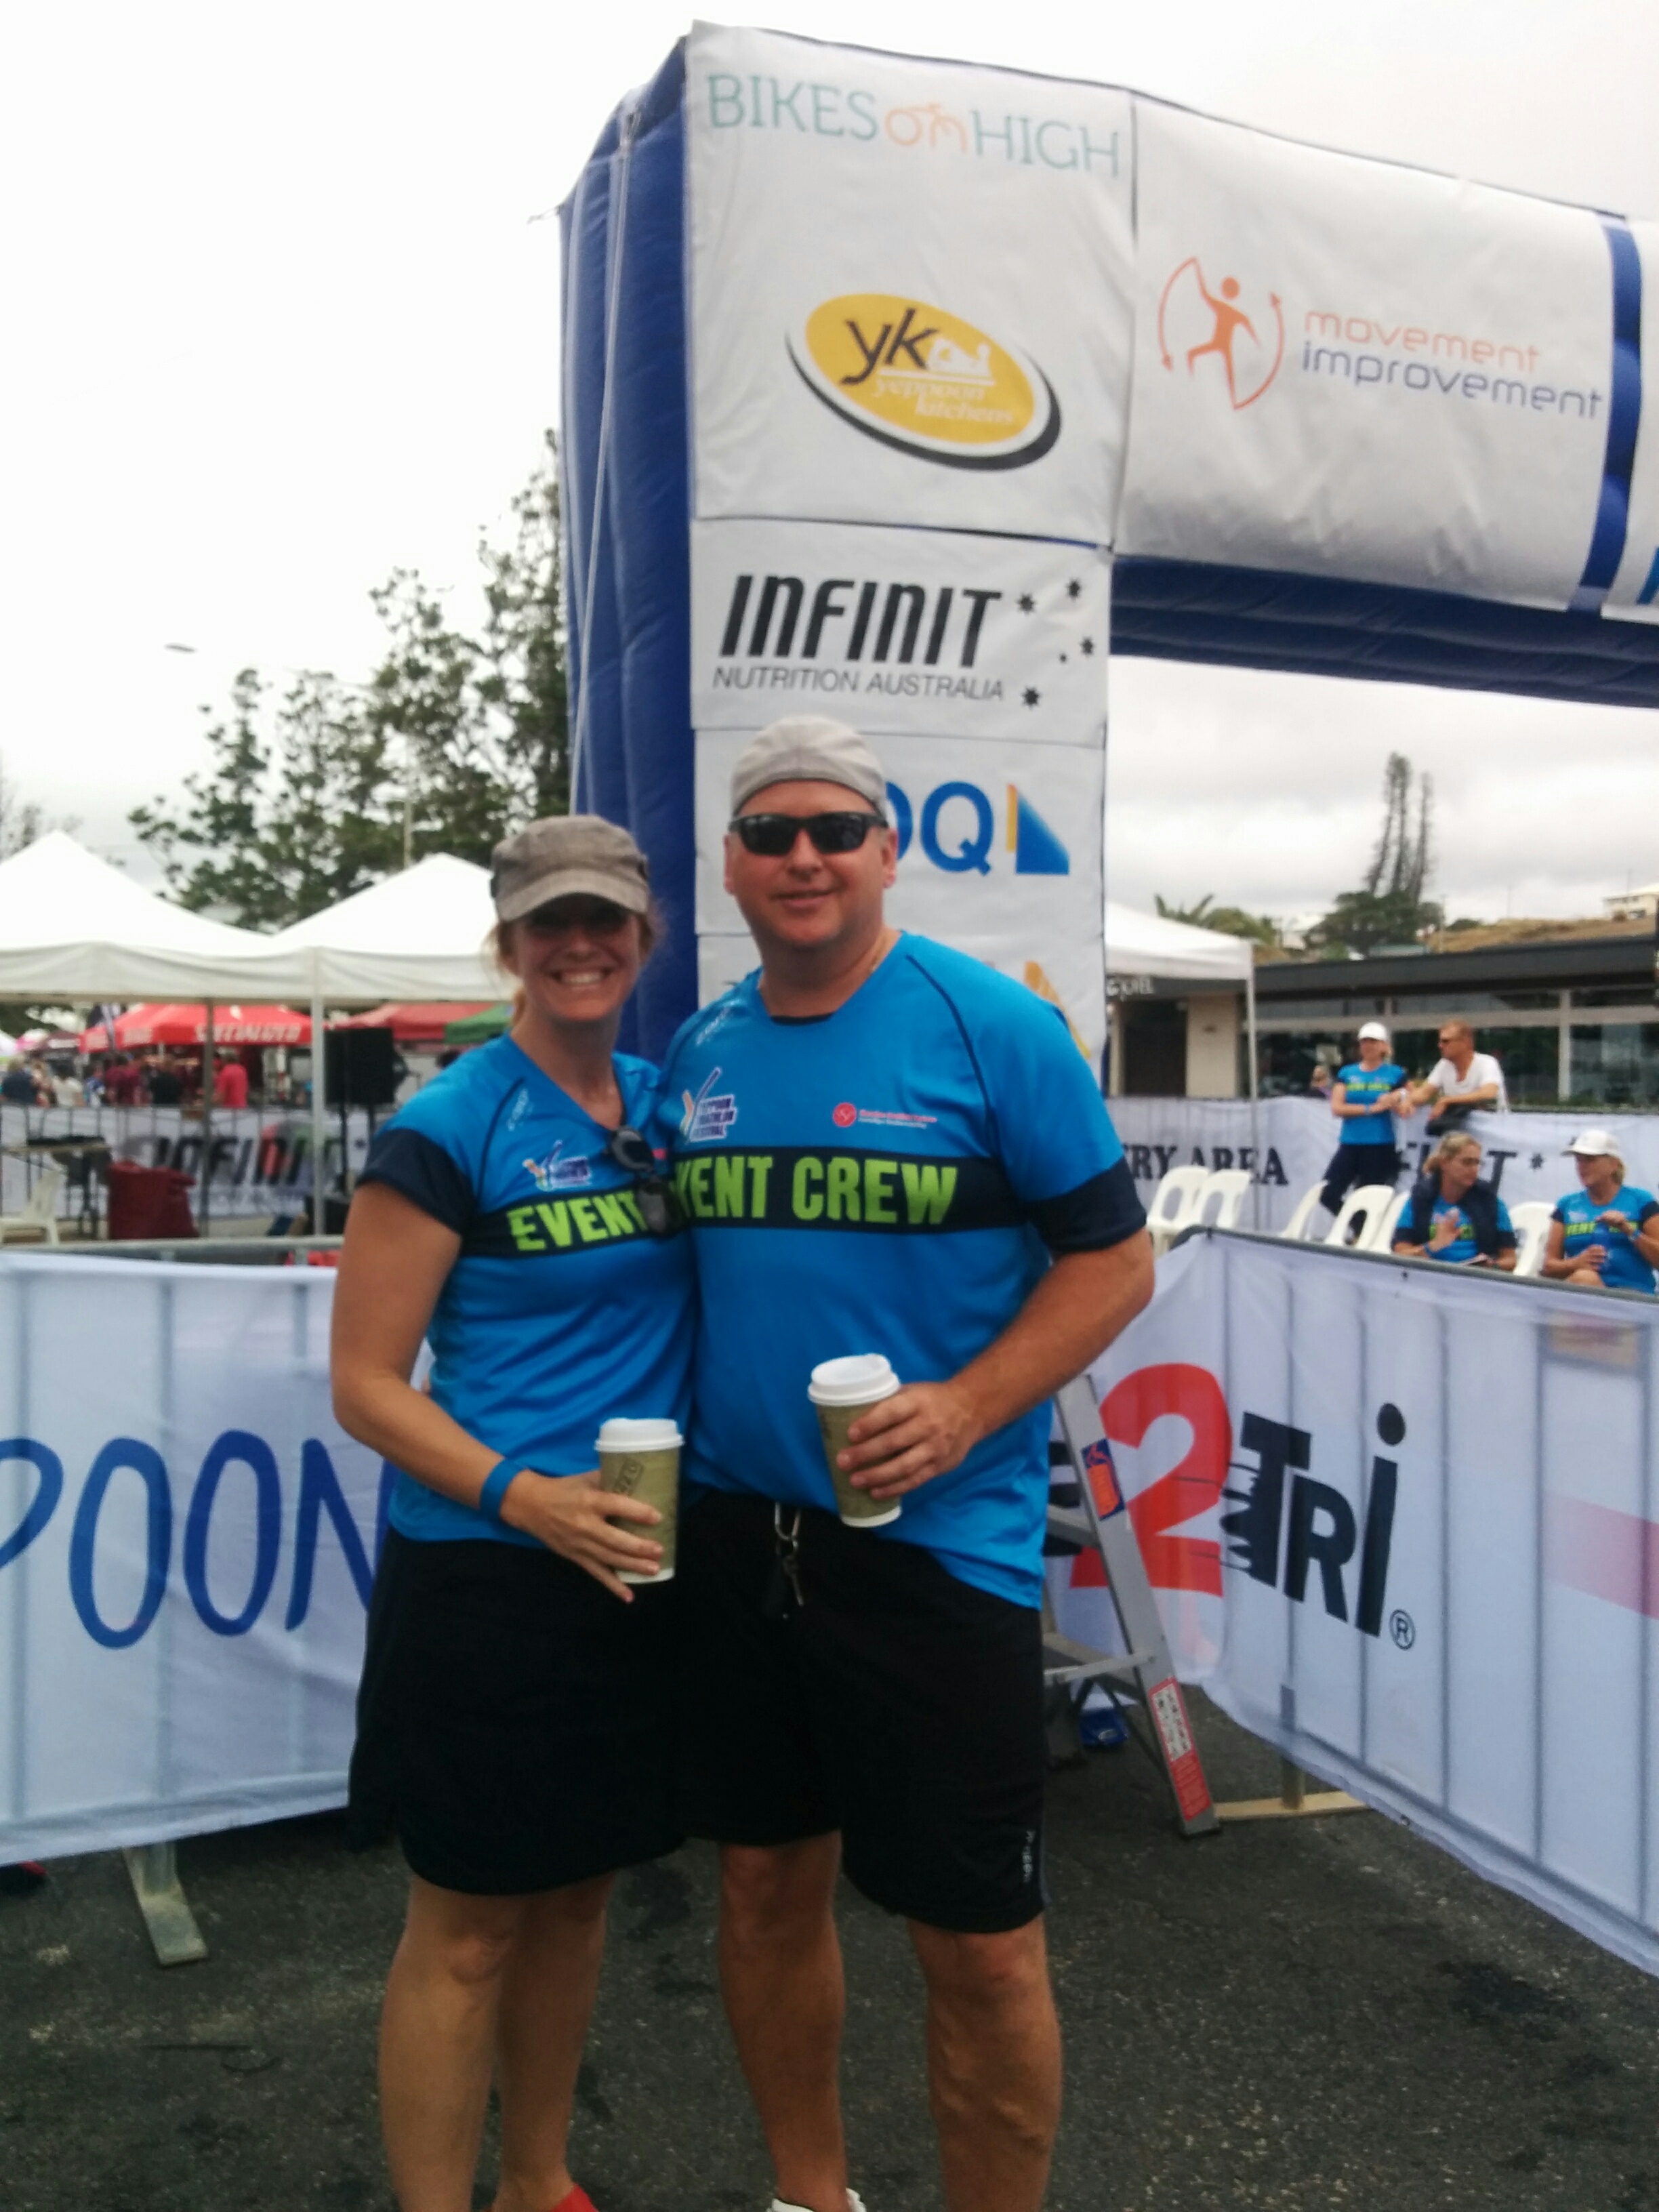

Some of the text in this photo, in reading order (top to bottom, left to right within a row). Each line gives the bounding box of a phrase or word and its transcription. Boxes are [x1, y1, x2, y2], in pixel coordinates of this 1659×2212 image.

[840, 308, 939, 386] yk
[1305, 309, 1540, 373] movement
[1302, 341, 1603, 420] improvement
[719, 573, 1003, 669] INFINIT
[712, 666, 1004, 701] NUTRITION AUSTRALIA
[670, 1155, 773, 1218] VENT
[792, 1156, 958, 1225] CREW
[1123, 1144, 1178, 1181] RY
[507, 1189, 649, 1252] EVENT
